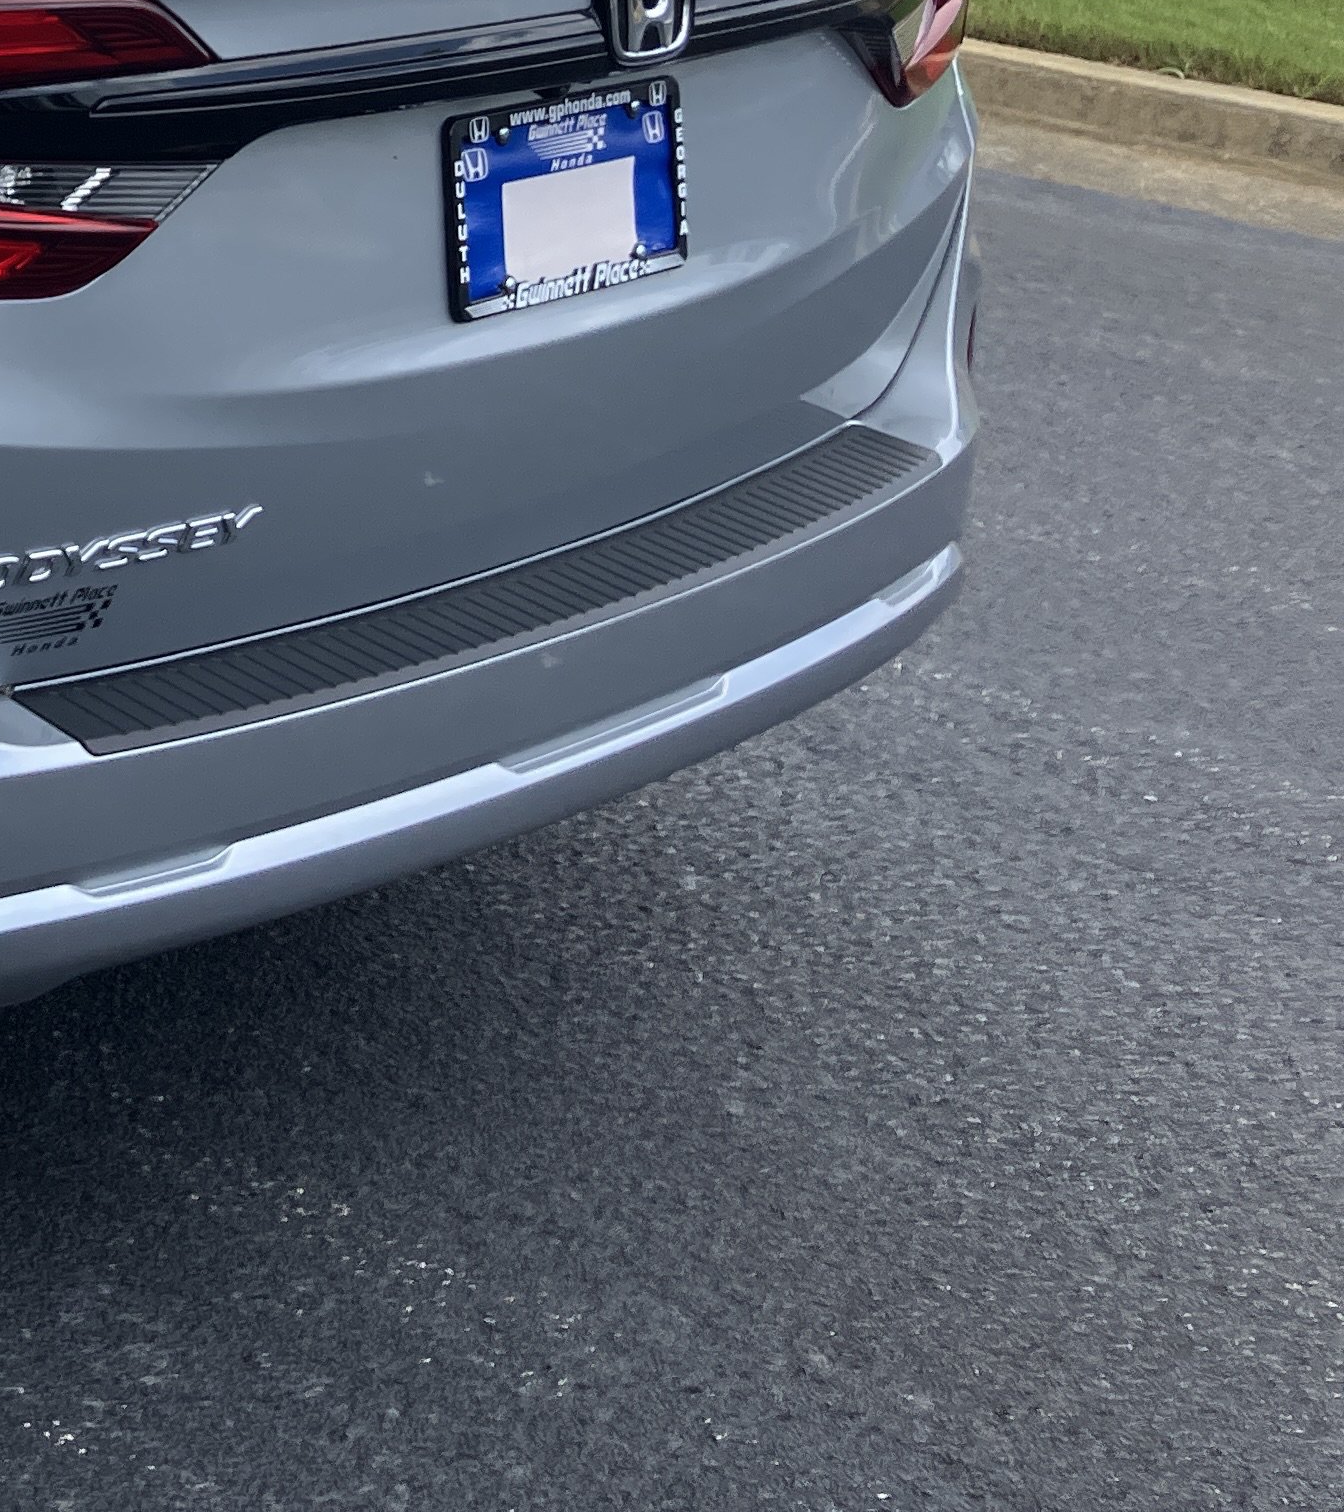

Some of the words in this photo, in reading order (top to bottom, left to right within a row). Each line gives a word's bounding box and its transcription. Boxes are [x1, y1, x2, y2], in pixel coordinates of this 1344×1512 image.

[509, 89, 633, 127] www.gphonda.com
[528, 117, 575, 141] Gwinnett
[550, 153, 593, 172] Honda
[674, 107, 690, 236] GEORGIA
[453, 160, 471, 284] DULUTH
[515, 265, 592, 309] Gwinnett
[593, 258, 640, 290] Place
[11, 636, 79, 657] Honda
